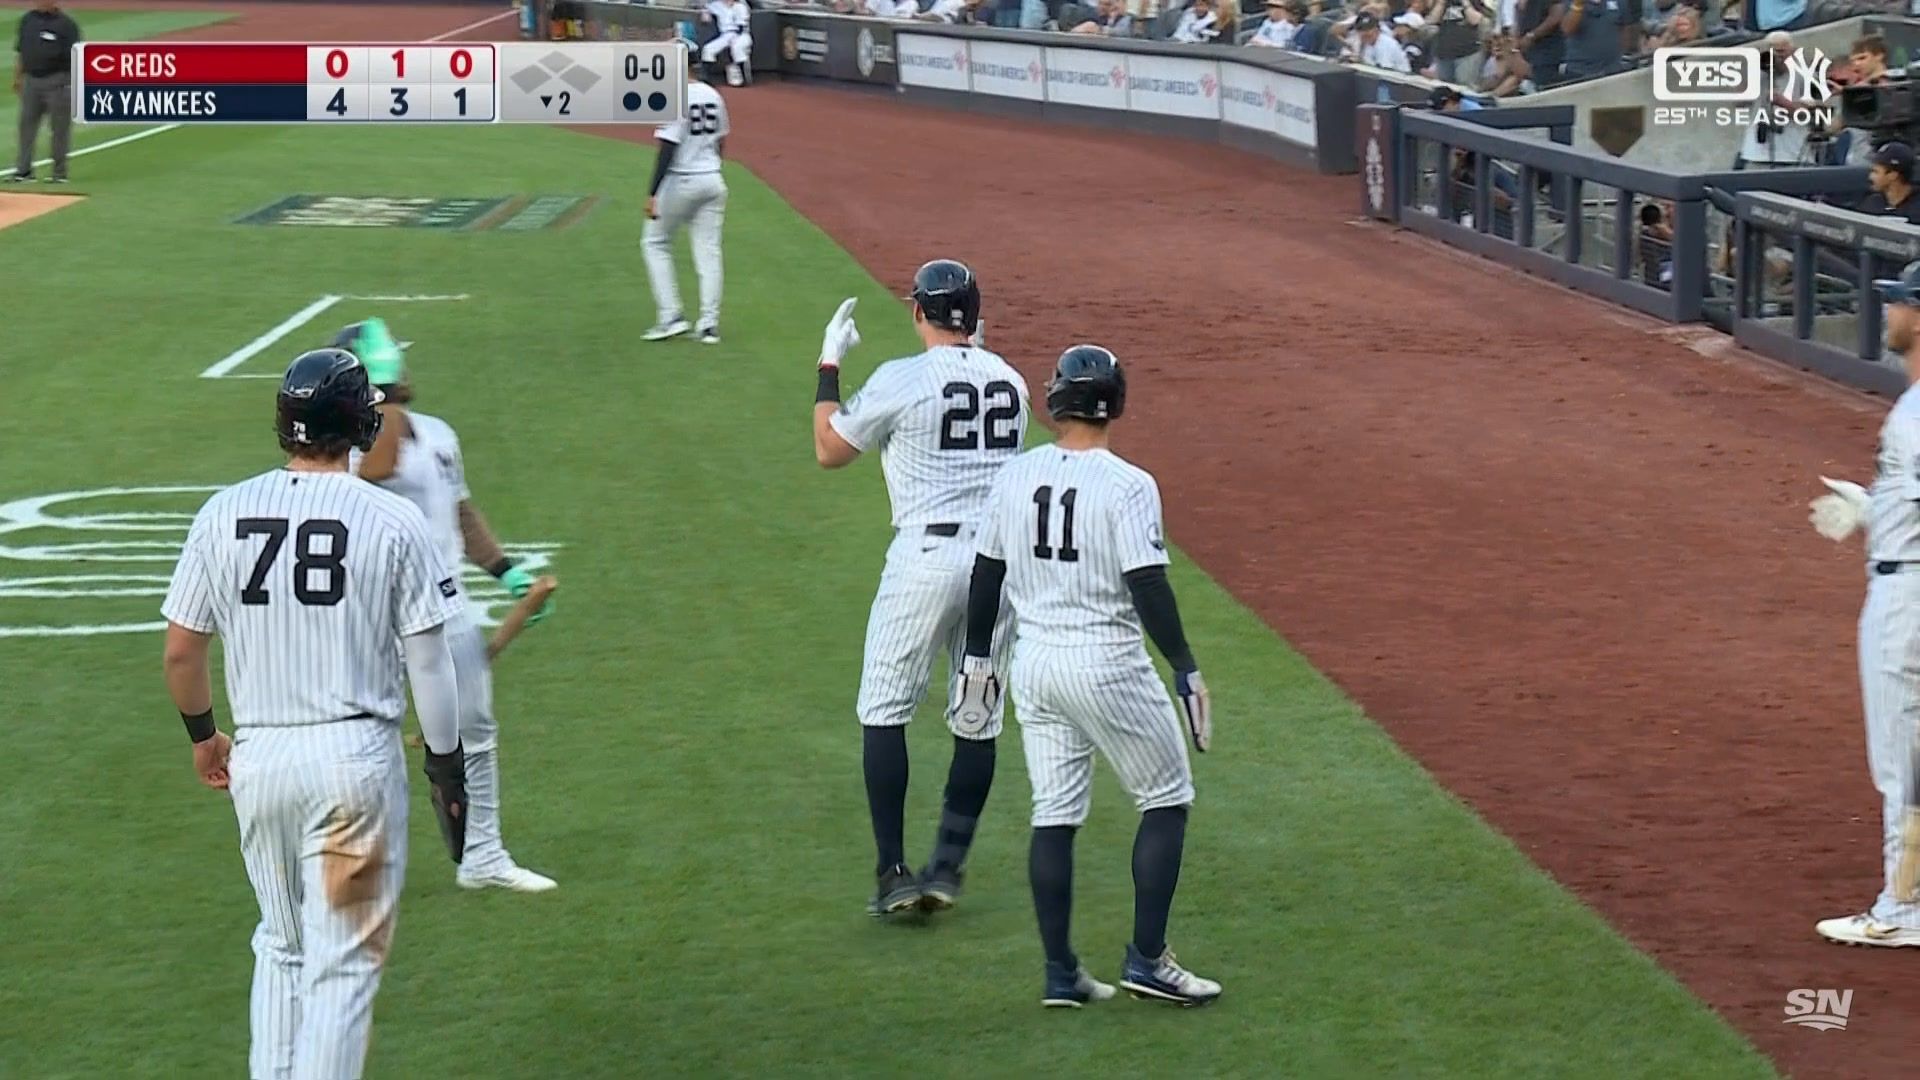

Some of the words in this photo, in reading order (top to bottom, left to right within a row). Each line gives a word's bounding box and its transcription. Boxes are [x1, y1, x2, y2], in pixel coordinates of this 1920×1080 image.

[940, 381, 1019, 450] 22
[236, 518, 348, 606] 78
[1033, 485, 1079, 562] 11
